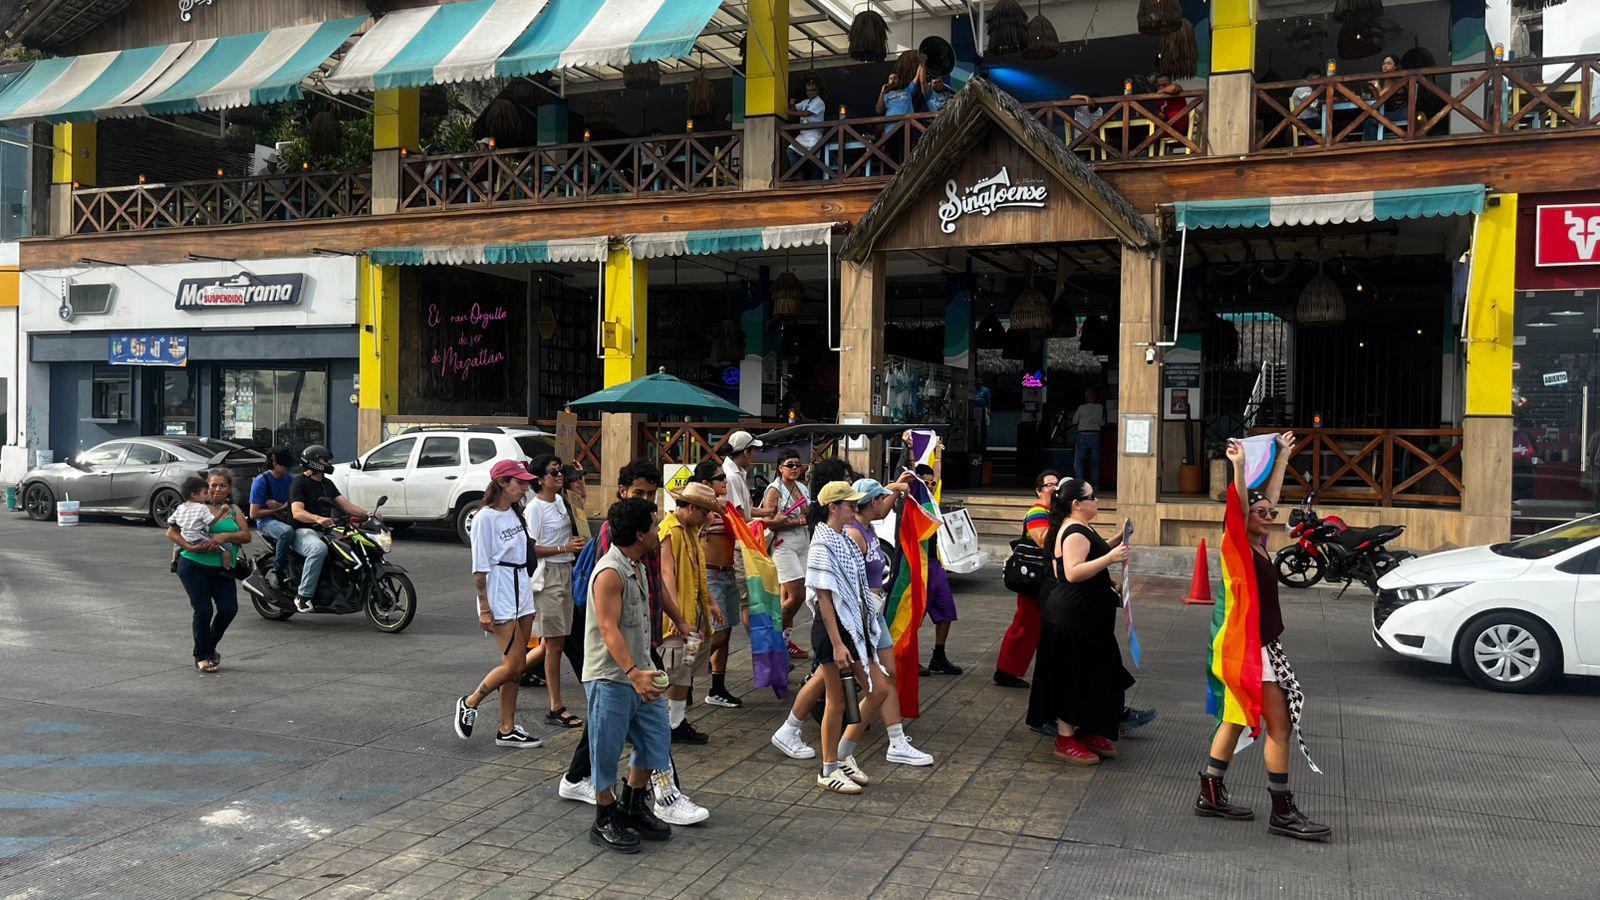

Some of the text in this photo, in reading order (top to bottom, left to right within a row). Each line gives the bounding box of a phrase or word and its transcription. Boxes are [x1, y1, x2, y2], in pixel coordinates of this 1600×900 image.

[938, 179, 1047, 233] Sinaloense
[203, 295, 243, 304] SUSPENDIDO
[428, 304, 441, 327] El
[470, 302, 507, 329] Orgullo
[459, 331, 482, 347] de ser
[431, 349, 441, 364] de
[1545, 374, 1566, 383] ABIERTO
